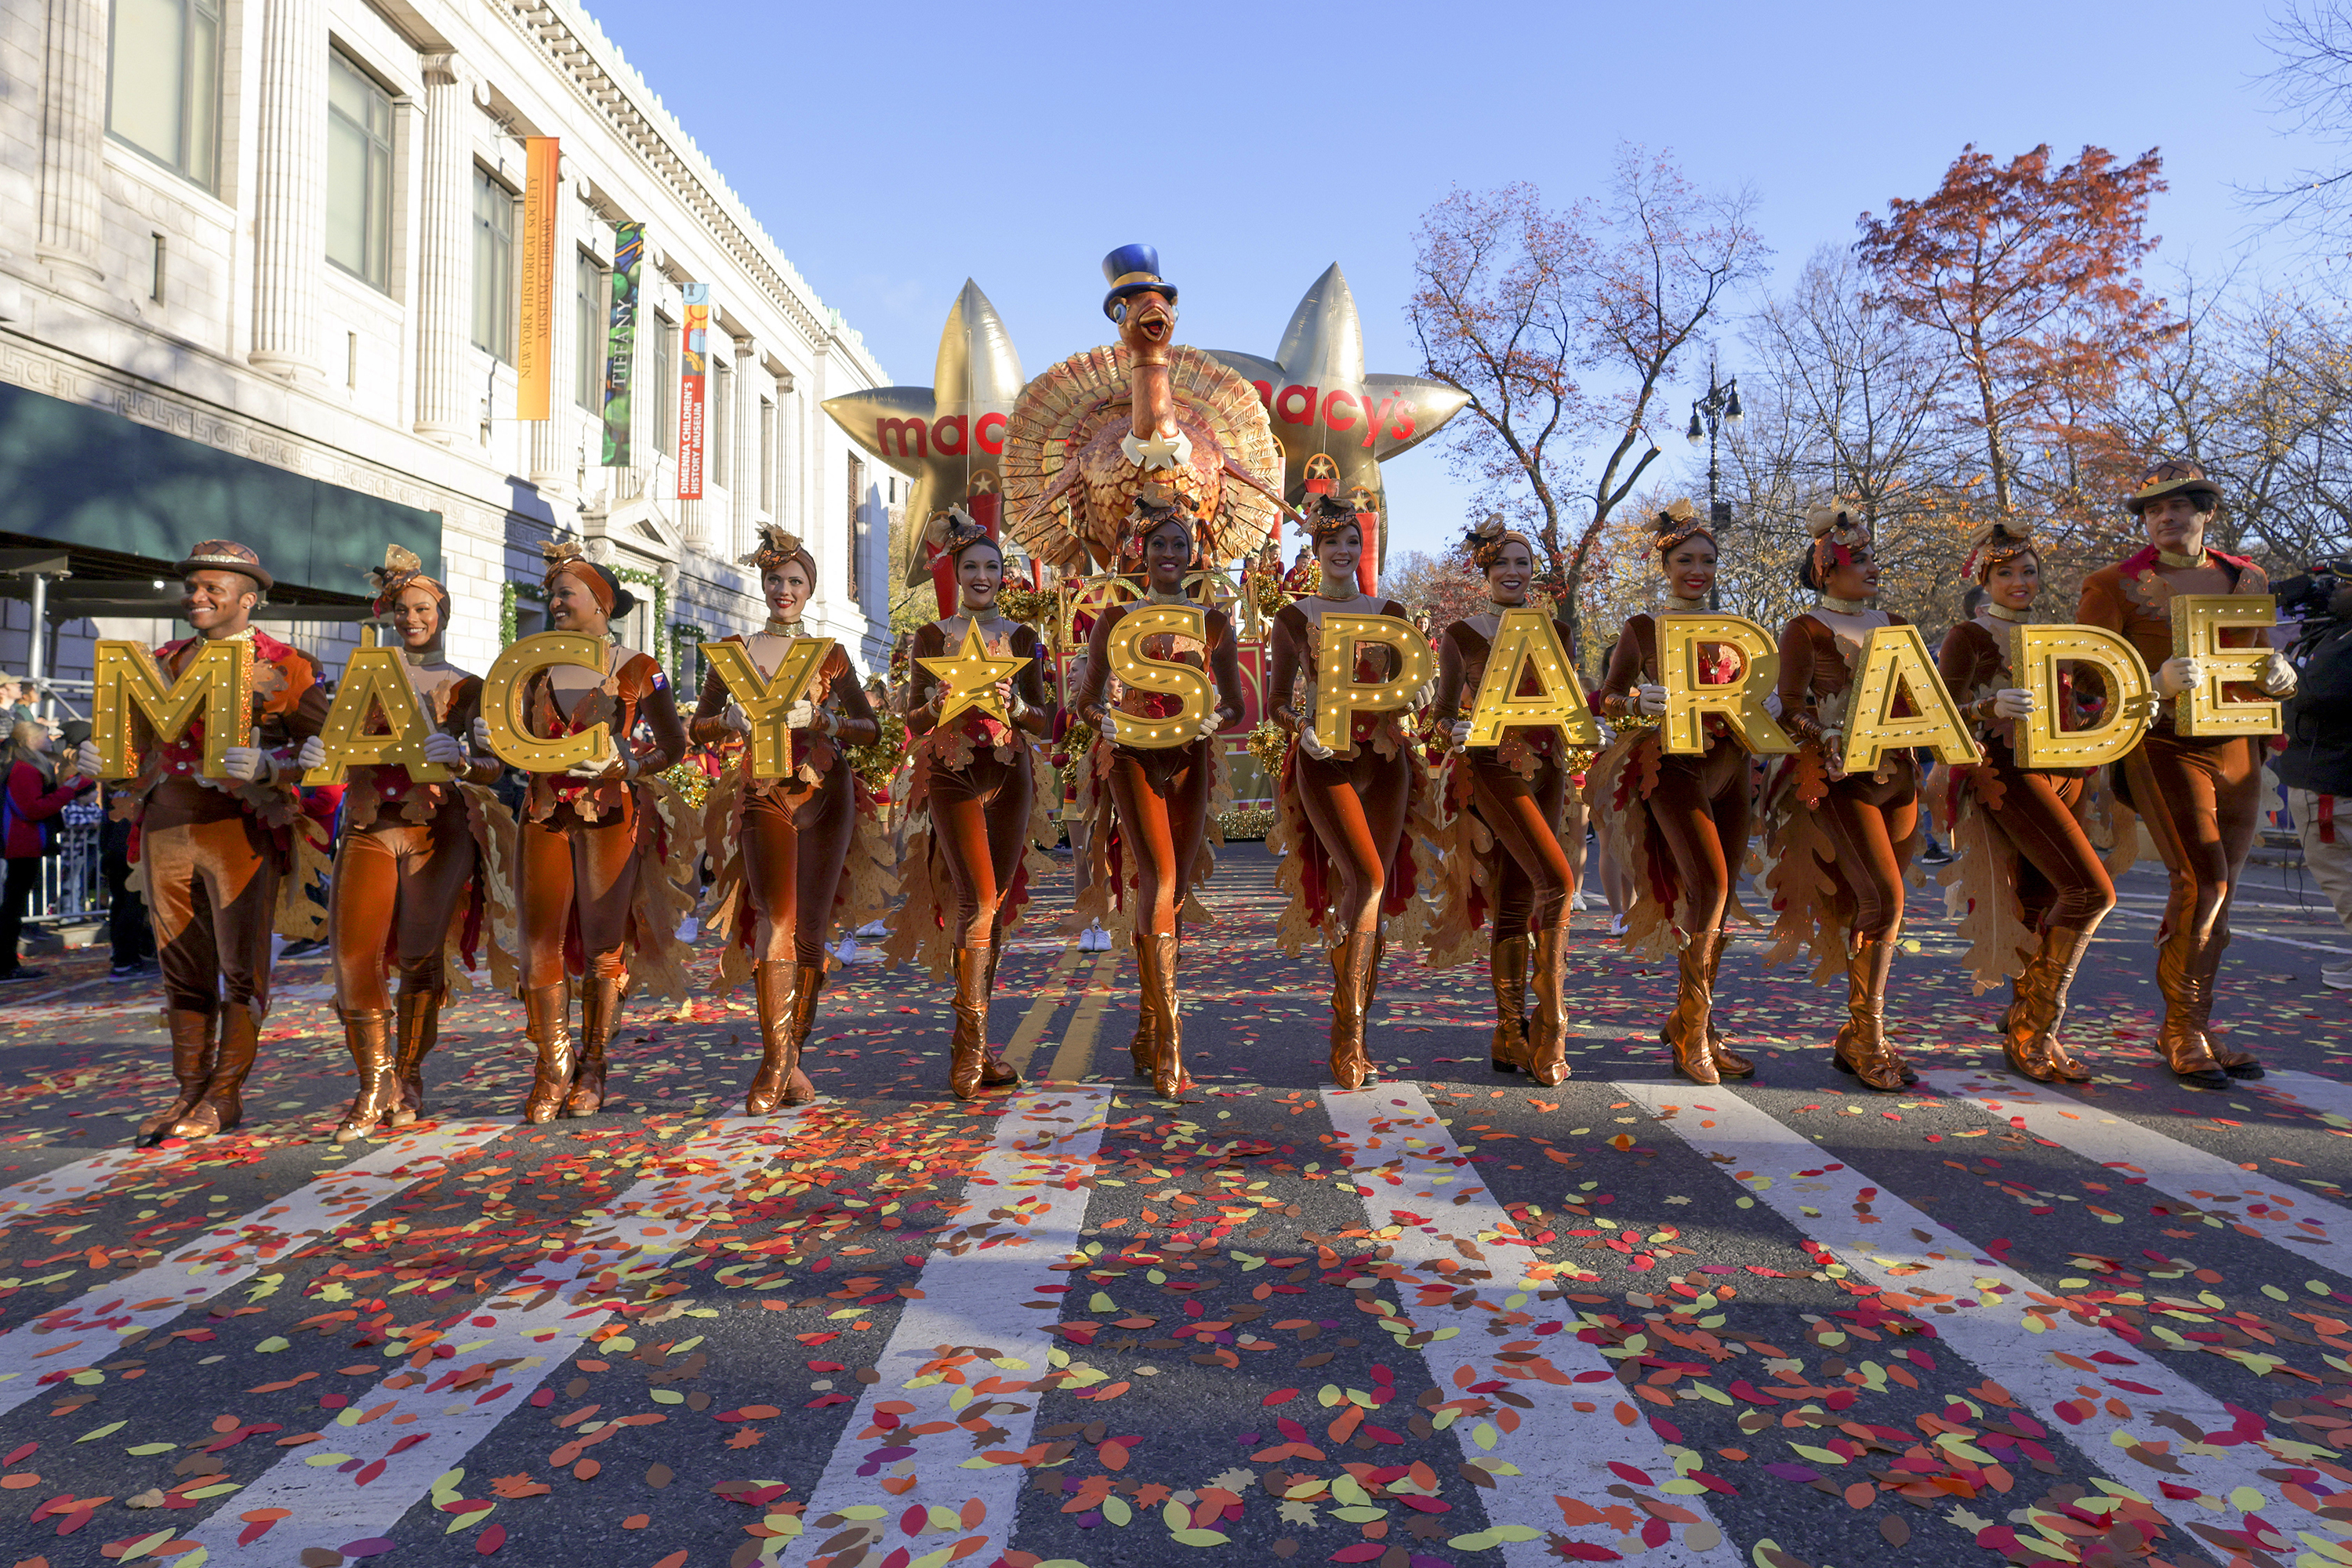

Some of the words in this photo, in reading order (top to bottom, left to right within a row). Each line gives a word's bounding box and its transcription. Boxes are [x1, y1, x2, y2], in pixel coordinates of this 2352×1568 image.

[527, 176, 539, 227] SOCIETY
[540, 216, 552, 267] LIBRARY
[523, 233, 536, 307] HISTORICAL
[538, 284, 550, 339] MUSEUM
[521, 313, 533, 379] NEW-YORK
[612, 298, 632, 389] TIFFANY
[681, 382, 693, 441] CHILDREN'S
[692, 402, 702, 448] MUSEUM
[877, 412, 1007, 458] mac
[680, 443, 690, 494] DIMENNA
[691, 451, 700, 494] HISTORY
